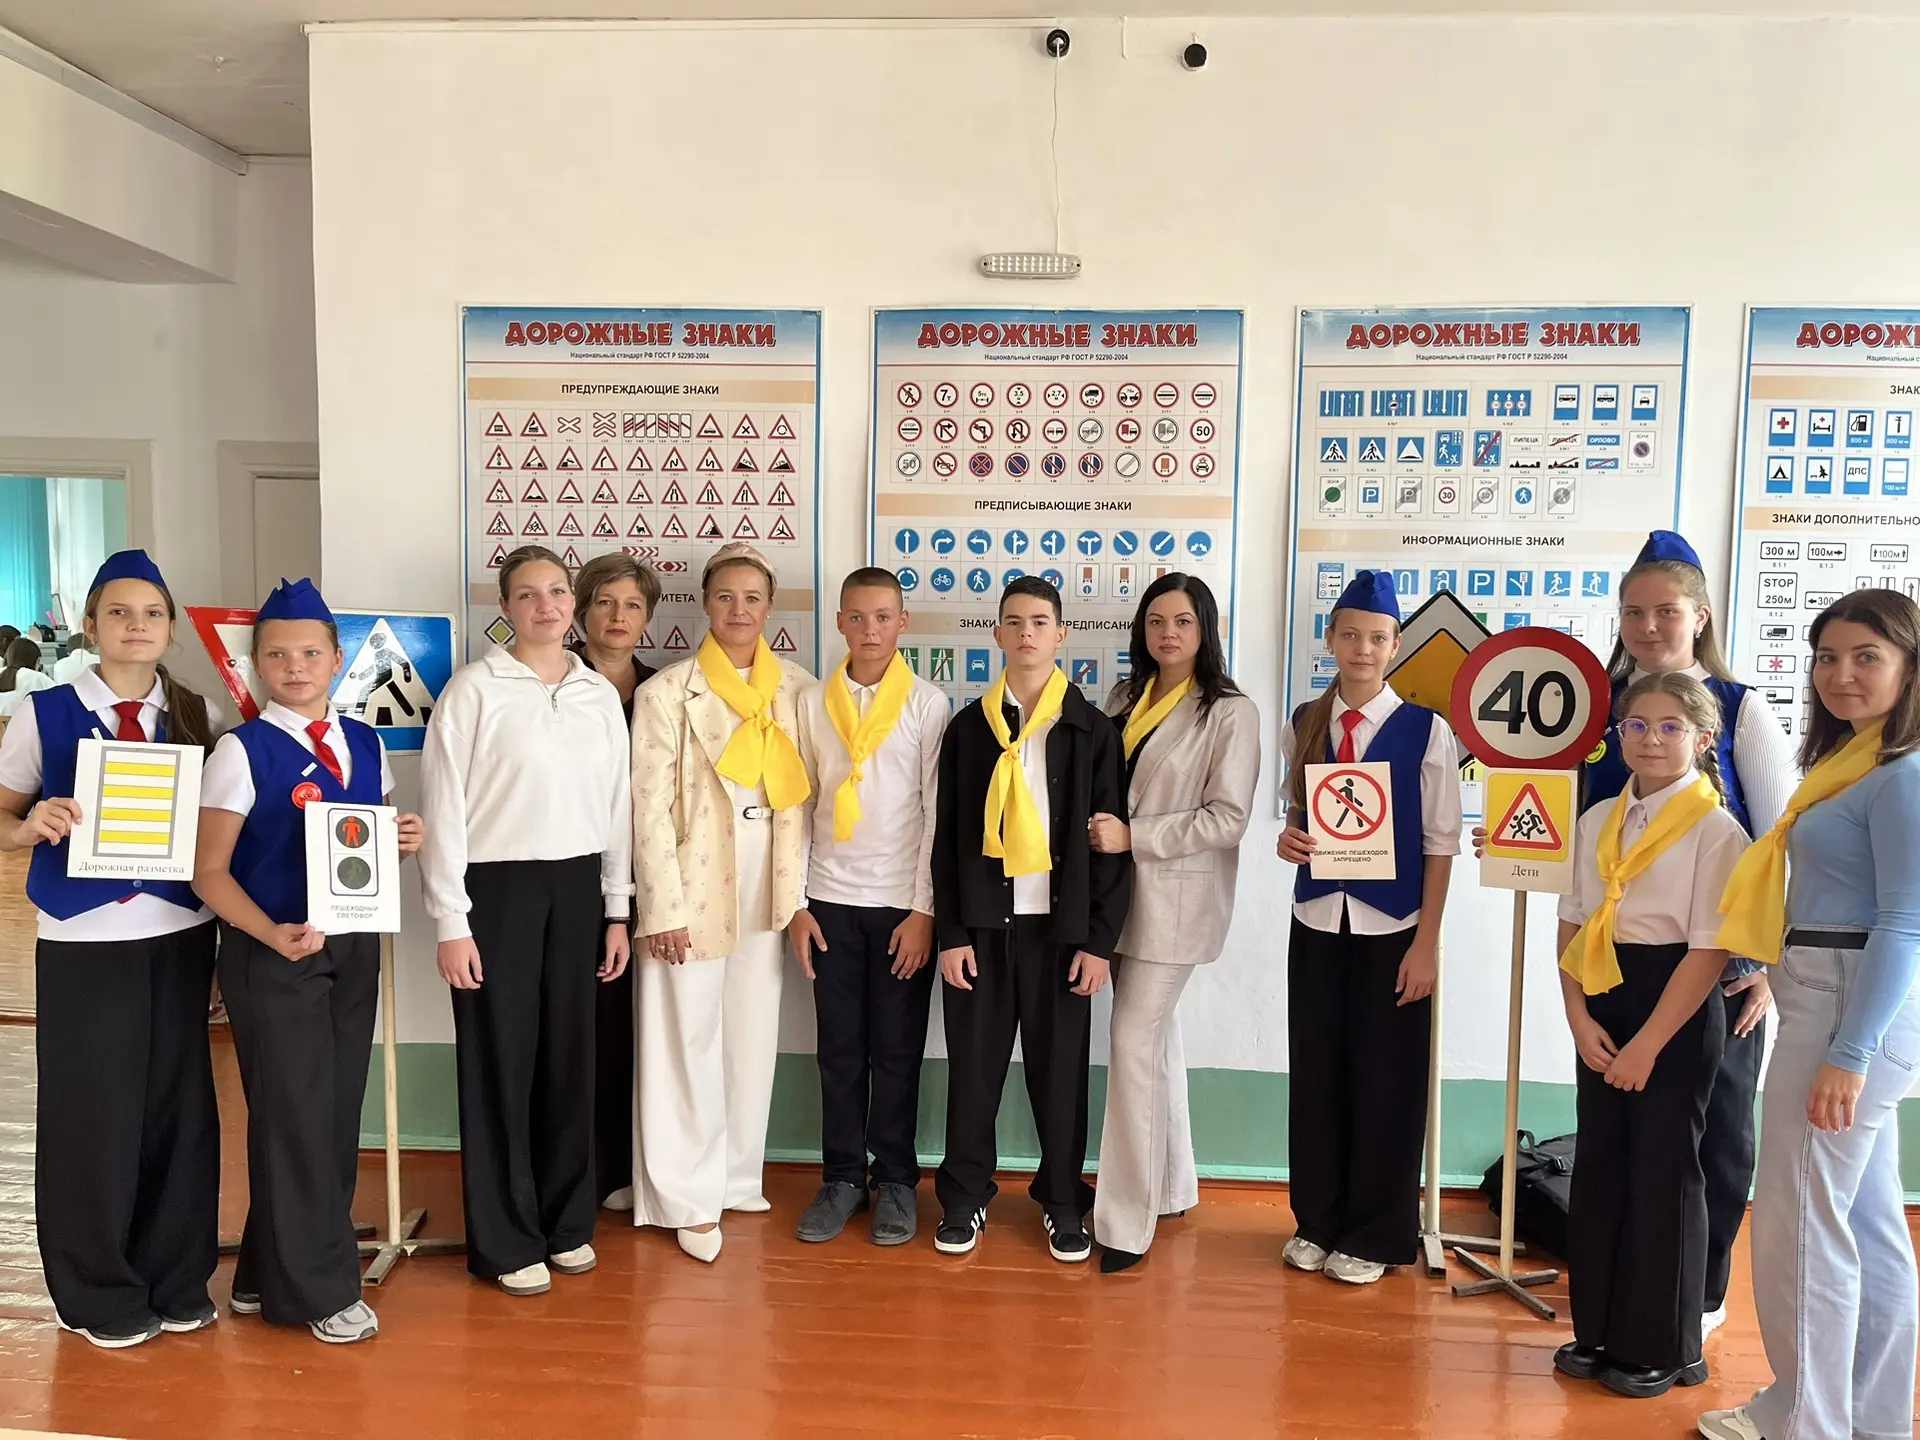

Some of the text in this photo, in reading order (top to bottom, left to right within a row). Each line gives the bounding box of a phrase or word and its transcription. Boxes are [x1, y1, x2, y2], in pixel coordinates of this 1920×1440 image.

[504, 320, 777, 348] ДОРОЖНЫЕ ЗНАКИ
[917, 322, 1198, 348] ДОРОЖНЫЕ ЗНАКИ
[1345, 322, 1641, 349] ДОРОЖНЫЕ ЗНАКИ
[984, 353, 1031, 362] Национальный
[1032, 354, 1059, 362] стандарт
[1060, 353, 1071, 361] РФ
[1416, 353, 1465, 362] Национальный
[1466, 354, 1495, 362] стандарт
[1533, 353, 1568, 361] 52290-2004
[1866, 354, 1914, 362] Национальный
[561, 384, 719, 396] ПРЕДУПРЕЖДАЮЩИЕ ЗНАКИ
[1196, 426, 1210, 436] 50
[1848, 467, 1867, 476] ДПС
[1442, 491, 1452, 499] 30
[974, 500, 1132, 513] ПРЕДПИСЫВАЮЩИЕ ЗНАКИ
[1772, 514, 1920, 526] ЗНАКИ ДОПОЛНИТЕЛЬНО
[1401, 535, 1565, 548] ИНФОРМАЦИОННЫЕ ЗНАКИ
[1765, 547, 1783, 556] 300
[1810, 547, 1833, 556] 100м
[1474, 573, 1491, 593] P
[1764, 578, 1794, 588] STOP
[660, 593, 696, 603] ИТЕТА
[1765, 595, 1792, 604] 250м
[1818, 597, 1835, 605] 300
[960, 619, 1135, 630] ЗНАКИ РЕДПИСАНИ
[1477, 670, 1577, 738] 40
[78, 861, 185, 874] Дорожная разметка
[1511, 865, 1539, 877] Дети
[331, 904, 379, 912] ПЕШЕХОДНЫЙ
